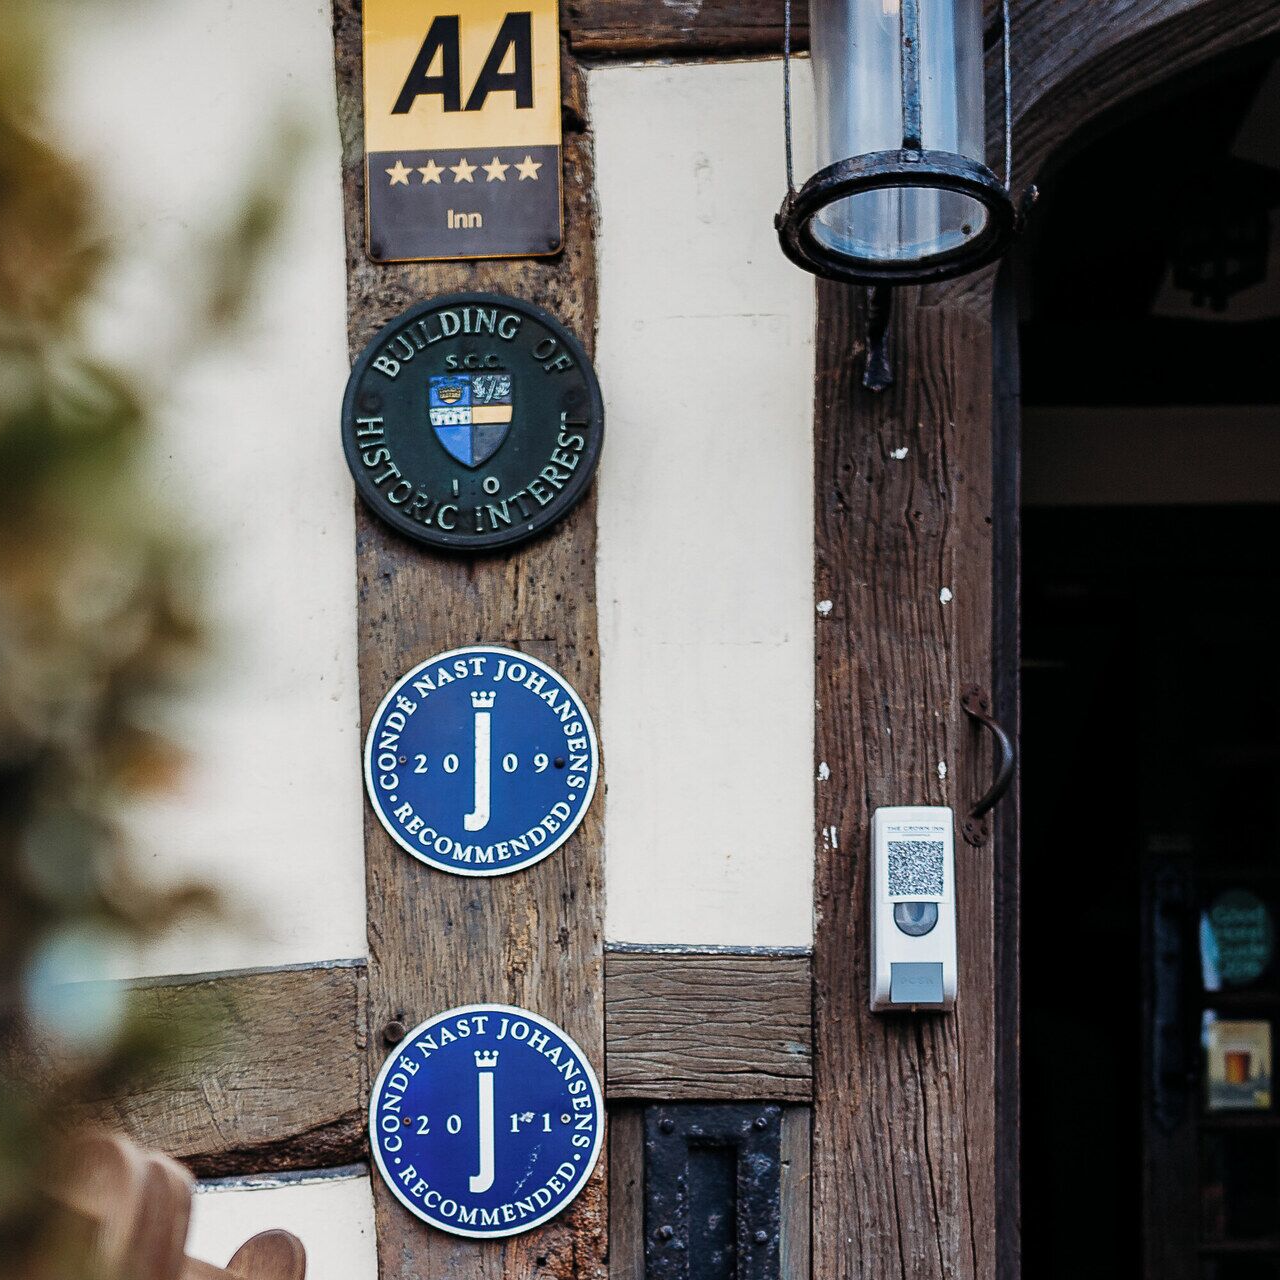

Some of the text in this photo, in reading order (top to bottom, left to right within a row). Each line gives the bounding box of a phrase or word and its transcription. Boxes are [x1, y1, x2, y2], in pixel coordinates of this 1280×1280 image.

[391, 11, 534, 115] AA
[447, 209, 483, 229] Inn
[372, 308, 574, 378] BUILDING OF
[356, 411, 589, 532] HISTORIC INTEREST
[377, 657, 589, 791] CONDÉ NAST JOHANSENS
[393, 801, 571, 864] RECOMMENDED
[382, 1016, 593, 1152] CONDÉ NAST JOHANSENS
[398, 1161, 576, 1226] RECOMMENDED
